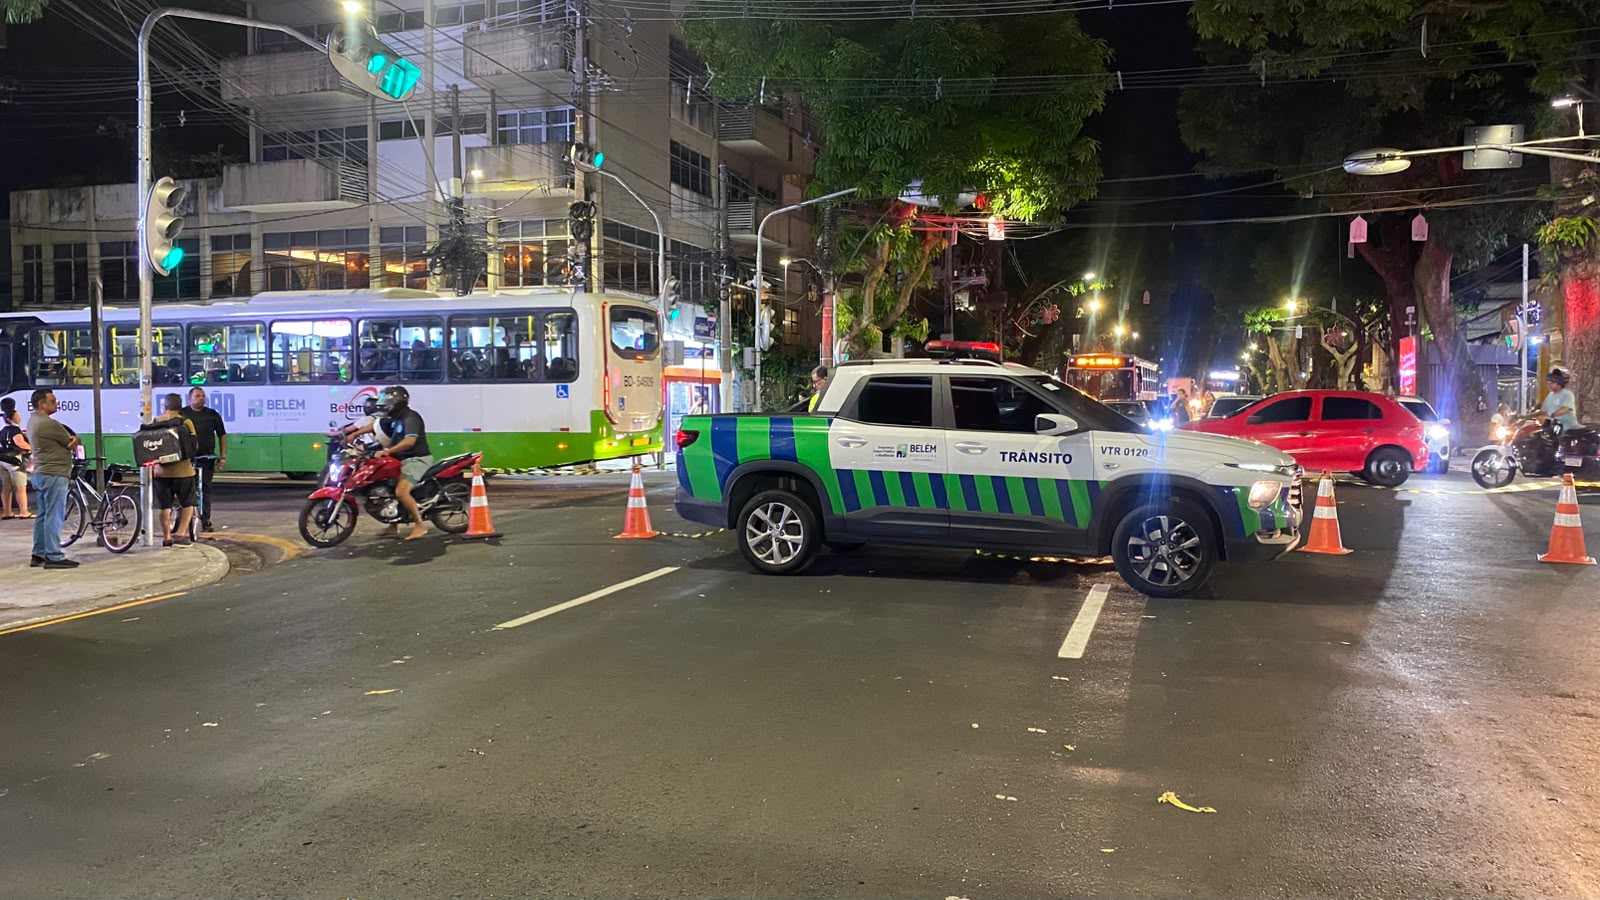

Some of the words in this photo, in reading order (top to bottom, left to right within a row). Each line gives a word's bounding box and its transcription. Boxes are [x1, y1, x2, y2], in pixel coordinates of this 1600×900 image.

[27, 400, 80, 411] B4609
[266, 397, 305, 410] BELÉM
[909, 442, 937, 453] BELÉM
[1100, 446, 1121, 455] VTR
[1123, 447, 1148, 457] 0120
[999, 449, 1073, 465] TRÂNSITO
